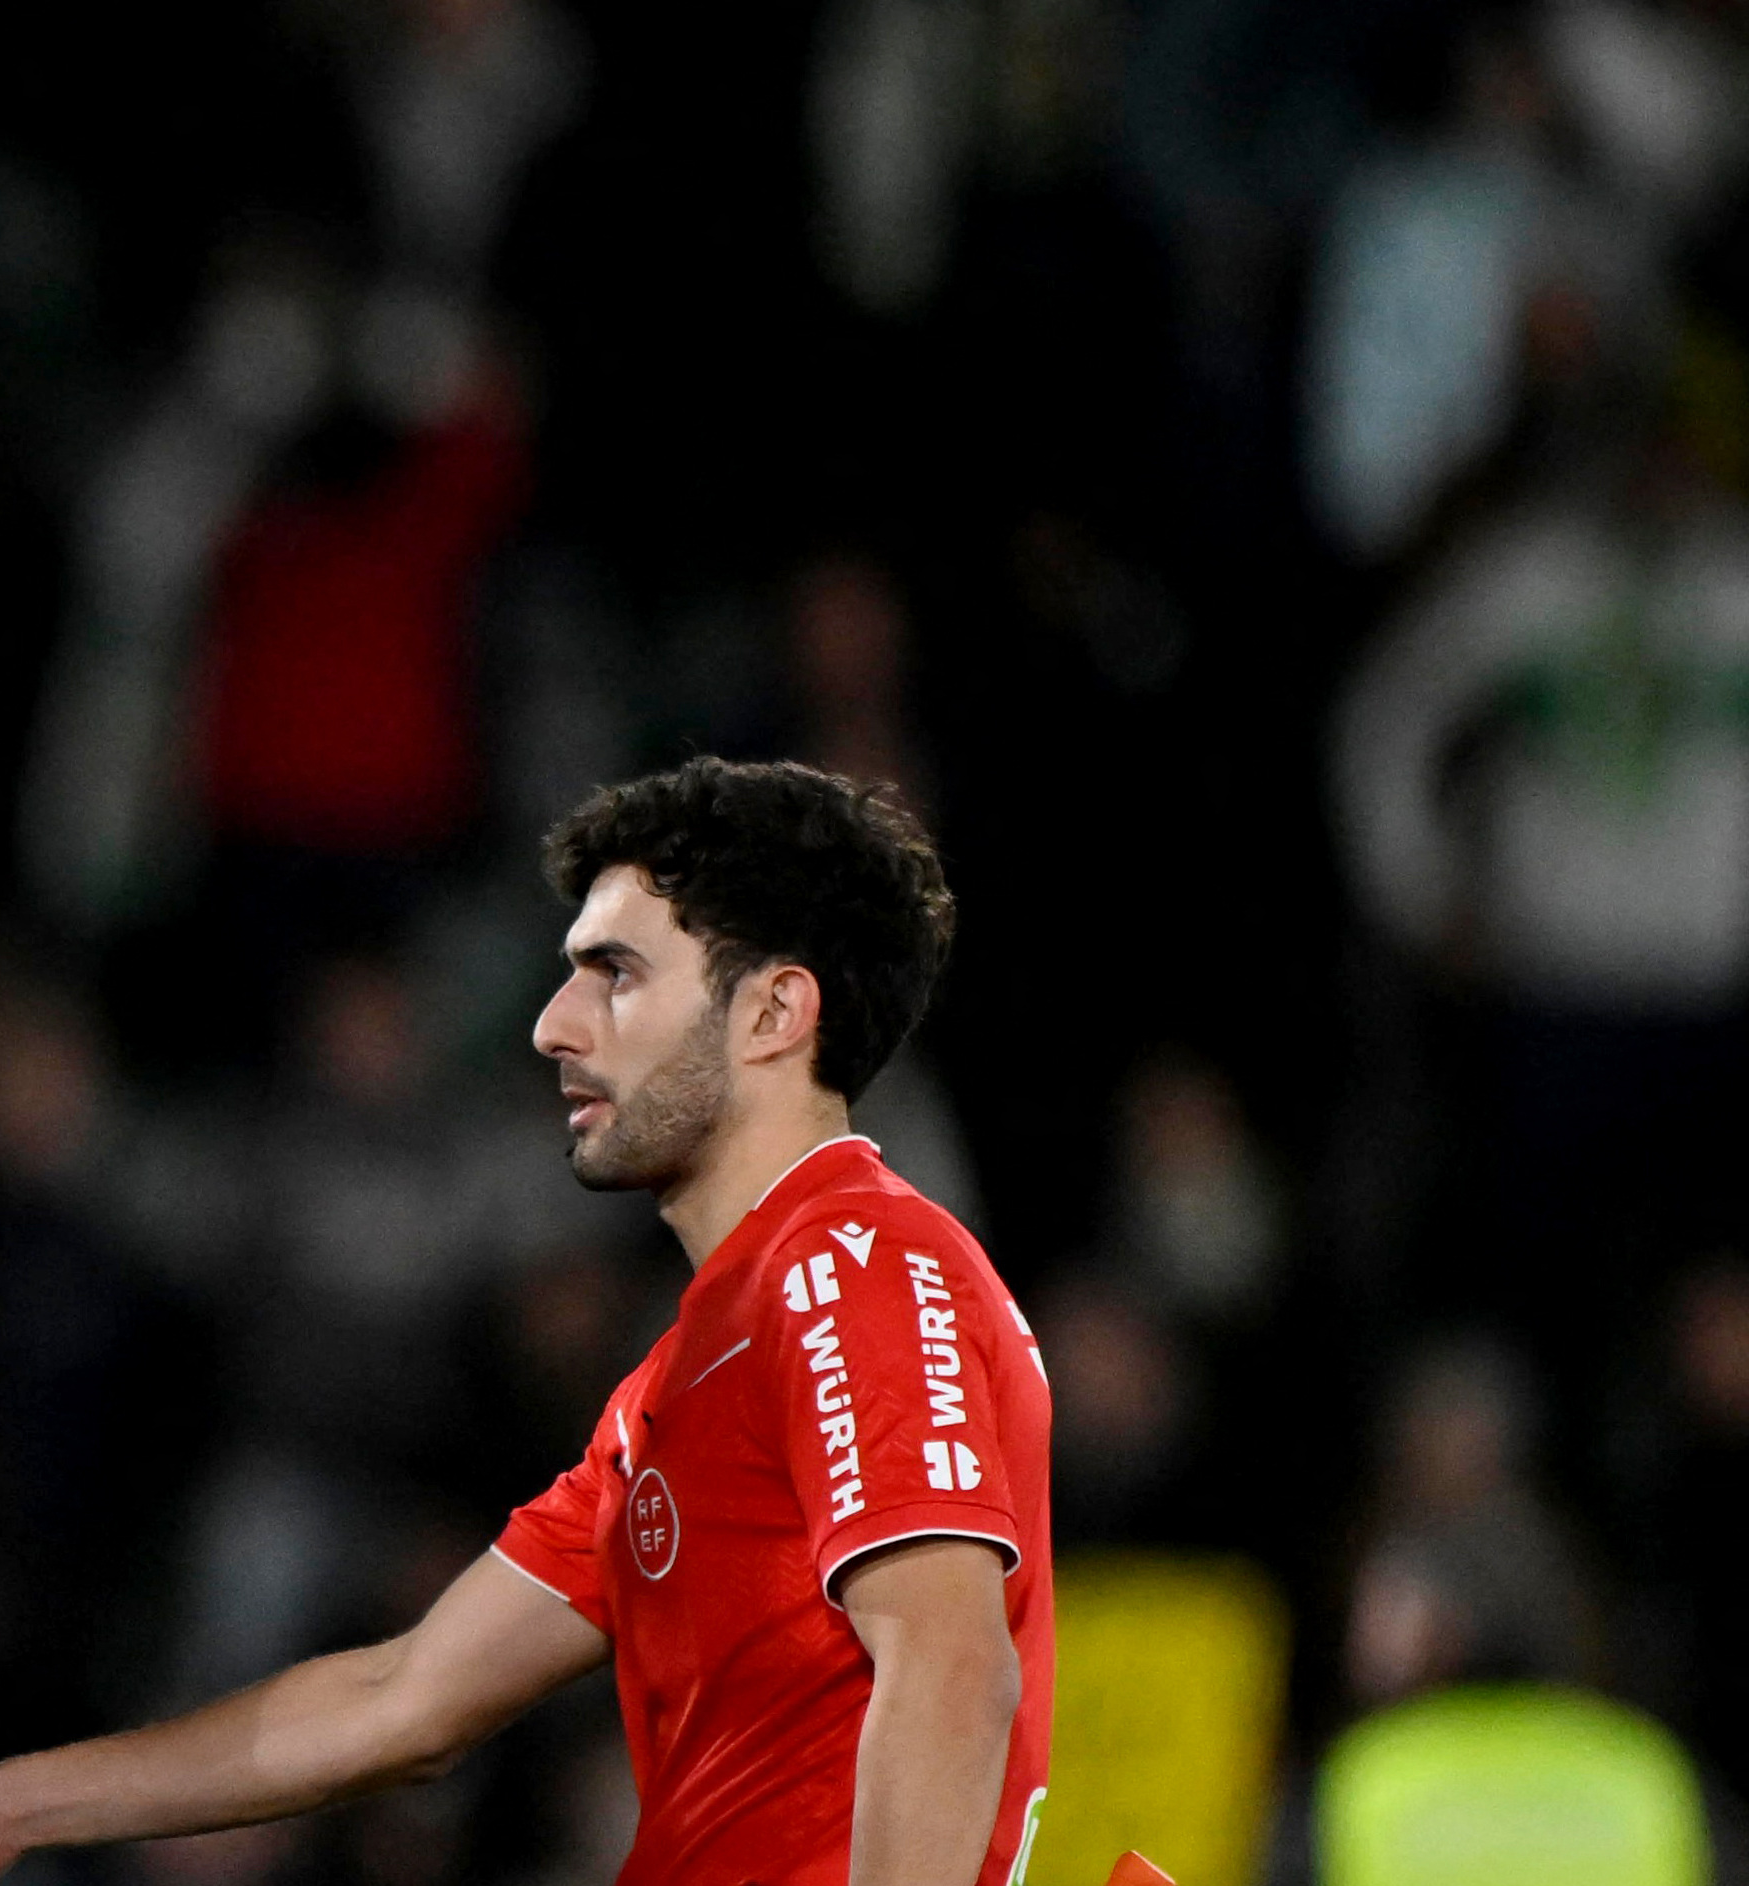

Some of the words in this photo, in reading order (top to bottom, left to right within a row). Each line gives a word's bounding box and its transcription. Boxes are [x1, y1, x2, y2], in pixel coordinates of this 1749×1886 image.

[904, 1252, 967, 1428] WÜRTH
[801, 1316, 866, 1523] WÜRTH
[636, 1497, 662, 1522] RF
[639, 1528, 665, 1554] EF
